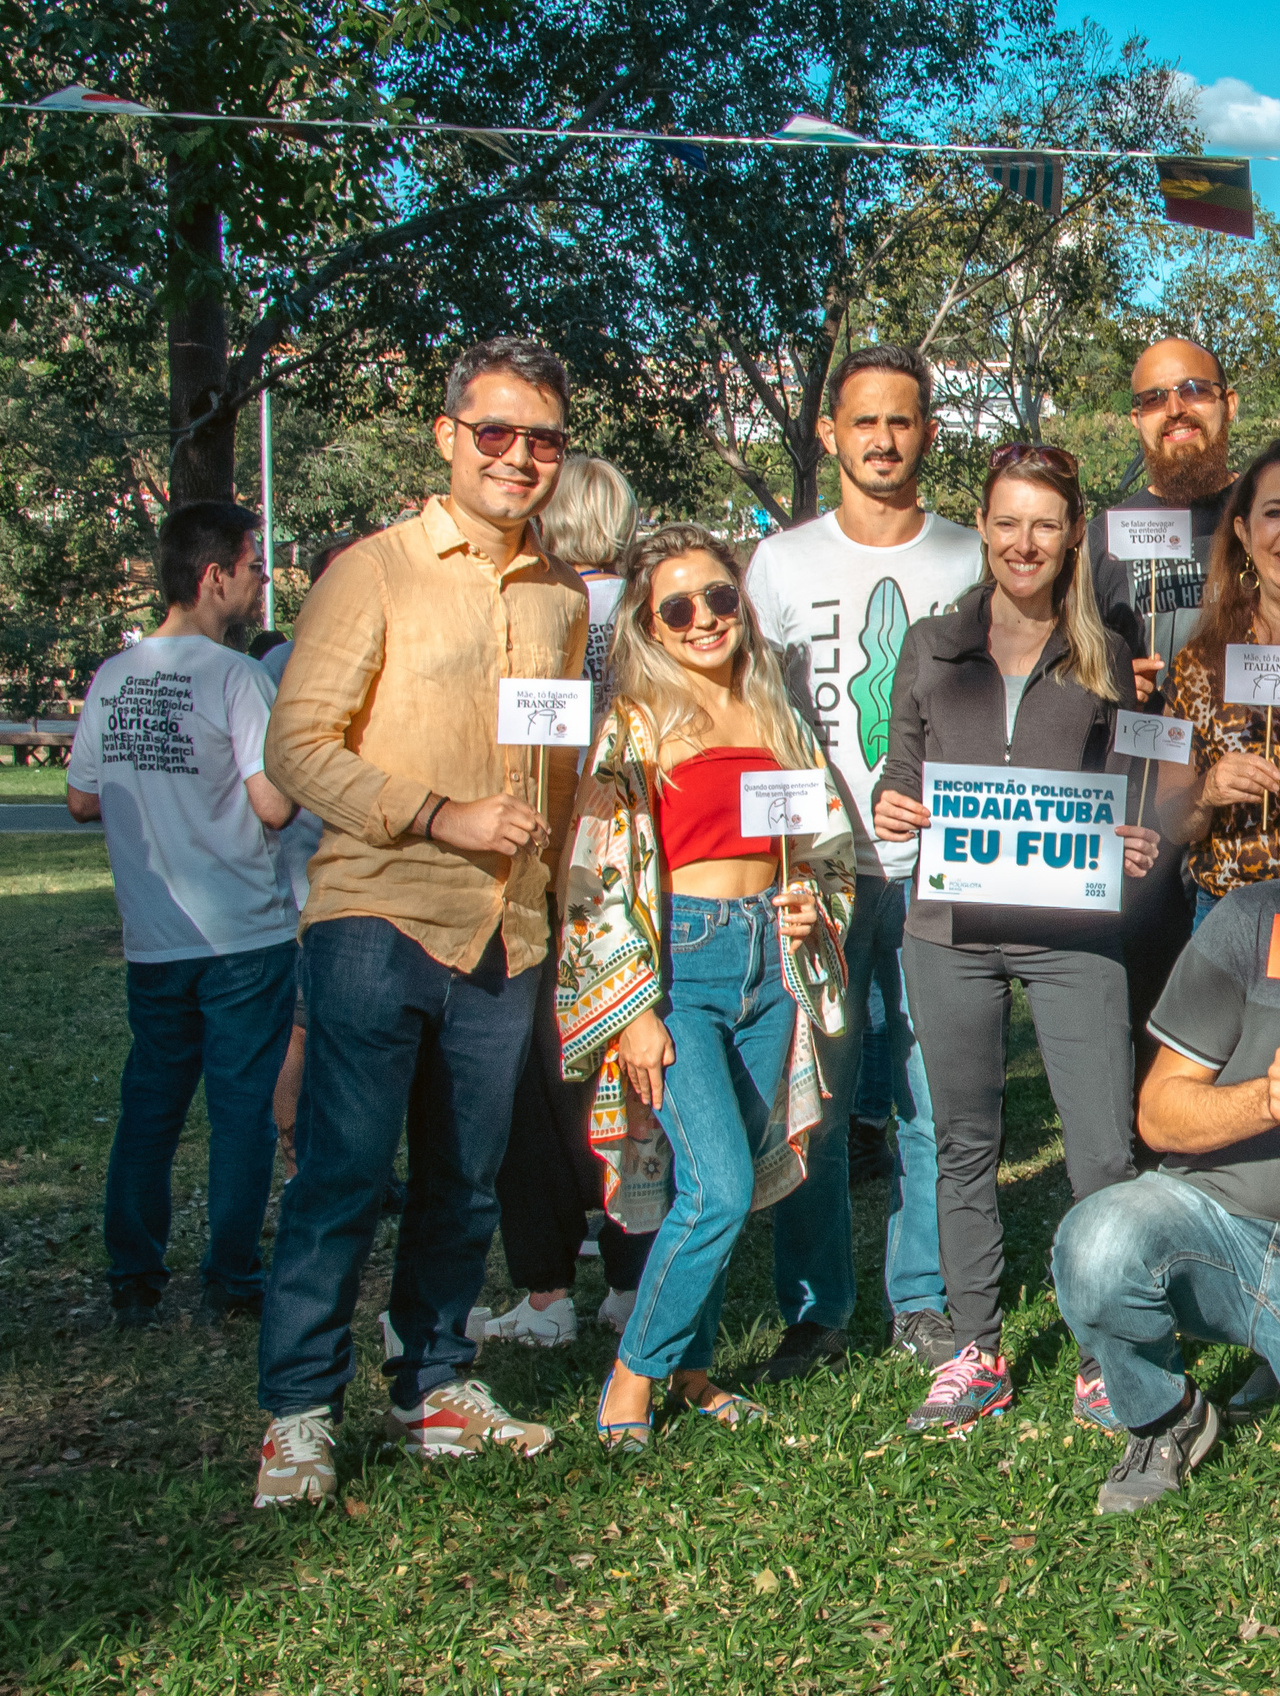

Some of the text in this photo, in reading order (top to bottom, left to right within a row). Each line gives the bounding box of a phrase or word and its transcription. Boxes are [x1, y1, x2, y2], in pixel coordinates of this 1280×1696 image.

[1121, 520, 1175, 529] Se falar devagar
[1130, 534, 1166, 544] TUDO!
[1243, 653, 1262, 663] Mãe,
[1263, 653, 1271, 662] tô
[811, 599, 840, 747] HOLLI
[517, 690, 578, 700] Mãe, tô falando
[744, 783, 767, 792] Quando
[768, 783, 790, 791] consigo
[933, 779, 1115, 801] ENCONTRÃO POLIGLOTA
[784, 789, 808, 798] legenda
[932, 794, 1114, 824] INDAIATUBA
[943, 827, 1101, 871] EU FUI!
[1085, 882, 1106, 890] 30/07
[1085, 889, 1106, 898] 2023
